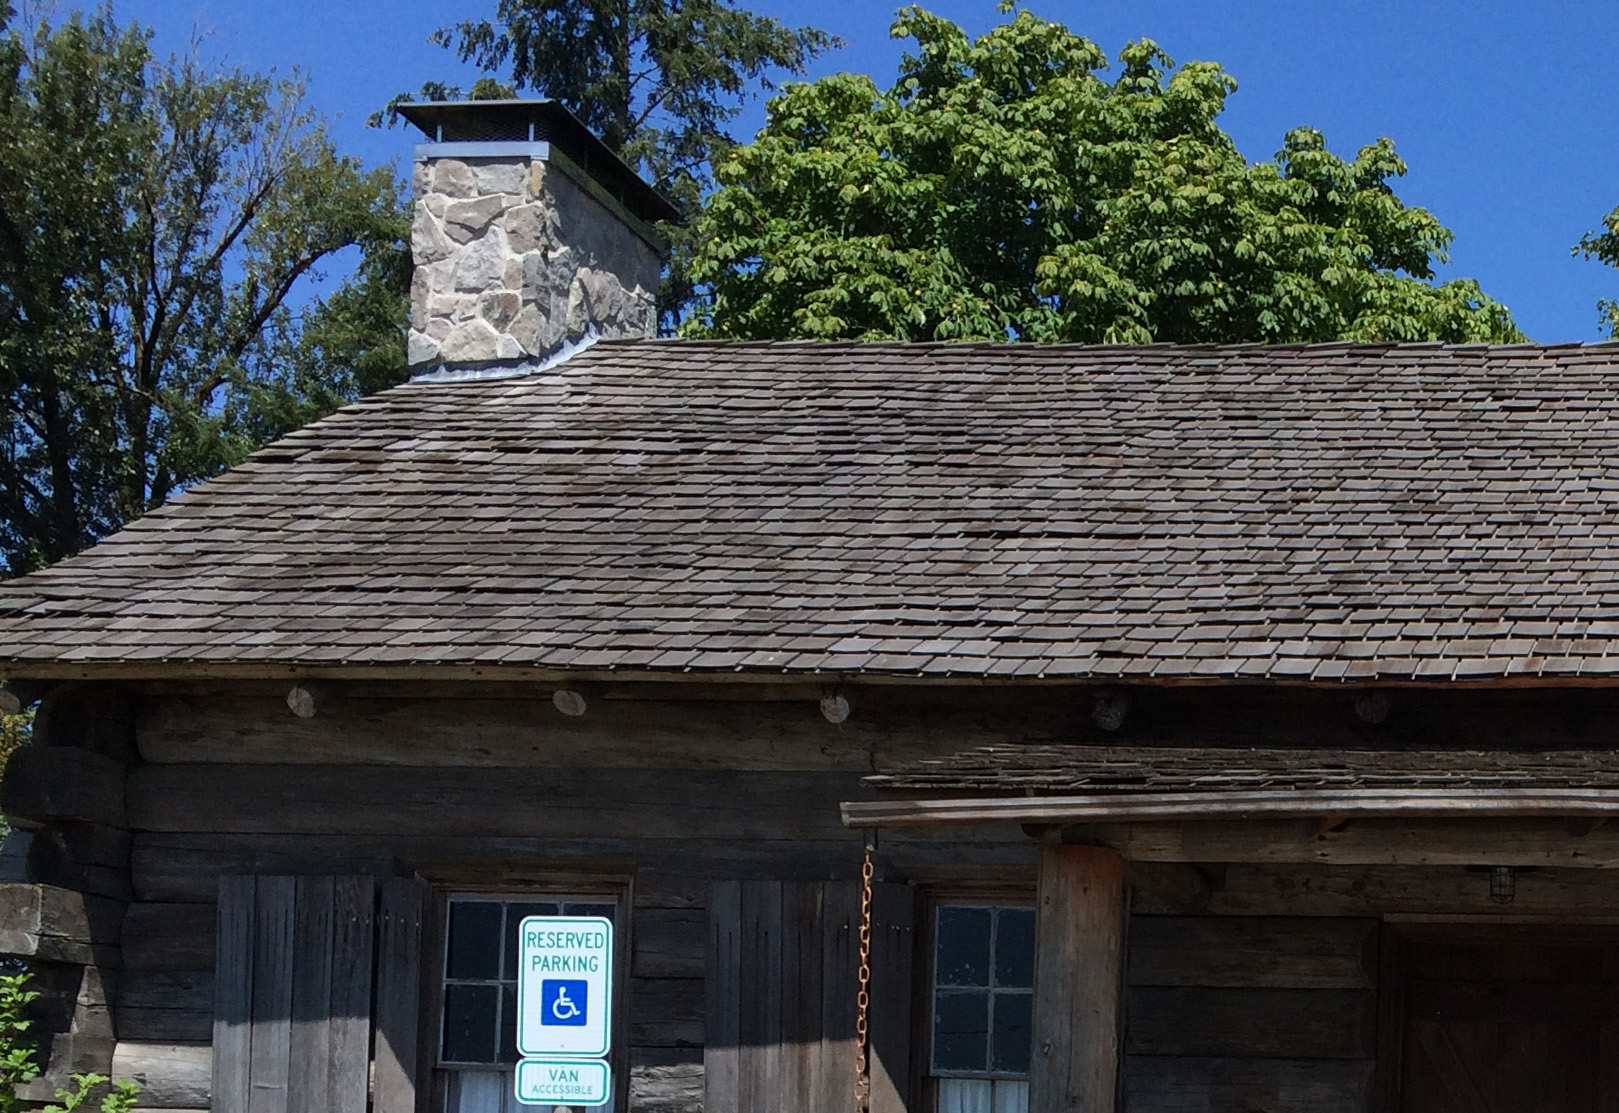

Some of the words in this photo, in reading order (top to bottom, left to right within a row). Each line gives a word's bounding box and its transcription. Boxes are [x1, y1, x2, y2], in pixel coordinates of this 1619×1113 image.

[527, 931, 604, 949] RESERVED
[532, 955, 598, 972] PARKING
[549, 1069, 579, 1082] VAN
[532, 1084, 593, 1095] ACCESSIBLE
